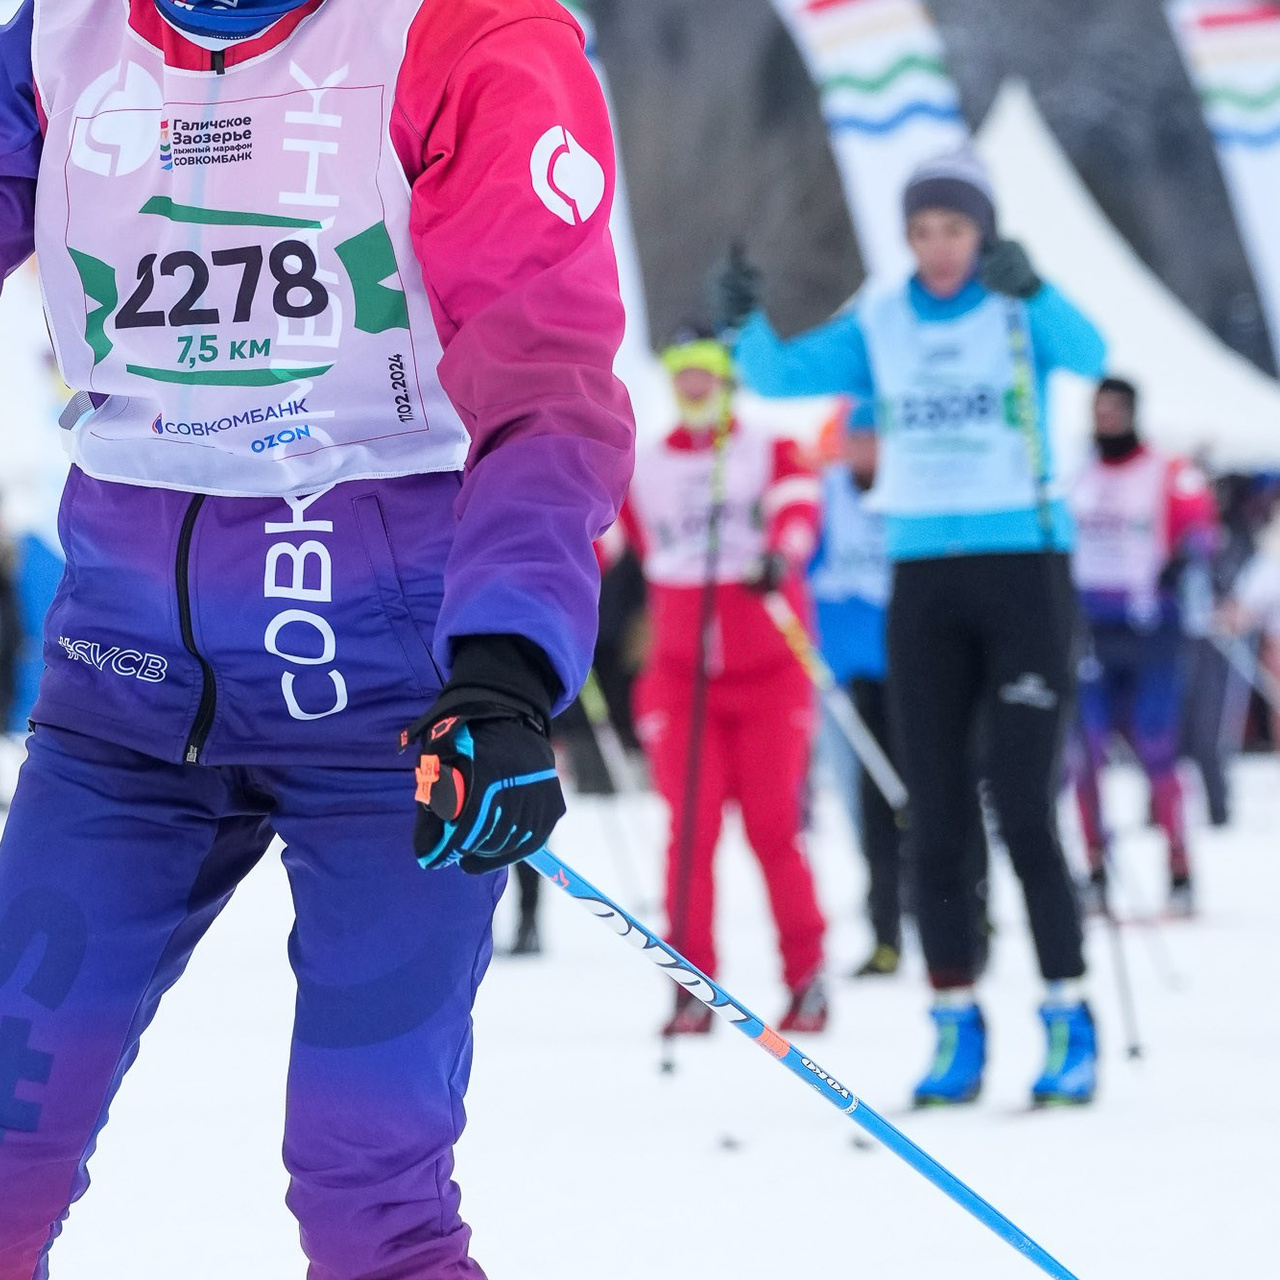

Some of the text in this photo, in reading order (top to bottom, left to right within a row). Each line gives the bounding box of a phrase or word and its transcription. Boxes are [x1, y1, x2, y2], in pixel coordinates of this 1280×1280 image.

[173, 116, 252, 131] Галичское
[173, 129, 252, 145] Заозерье
[173, 142, 252, 155] лыжный марафон
[174, 151, 252, 167] СОВКОМБАНК
[115, 239, 329, 329] 2278
[177, 335, 219, 368] 7,5
[165, 398, 310, 437] СОВКОМБАНК
[251, 424, 311, 453] OZON
[801, 1057, 851, 1099] YOKO
